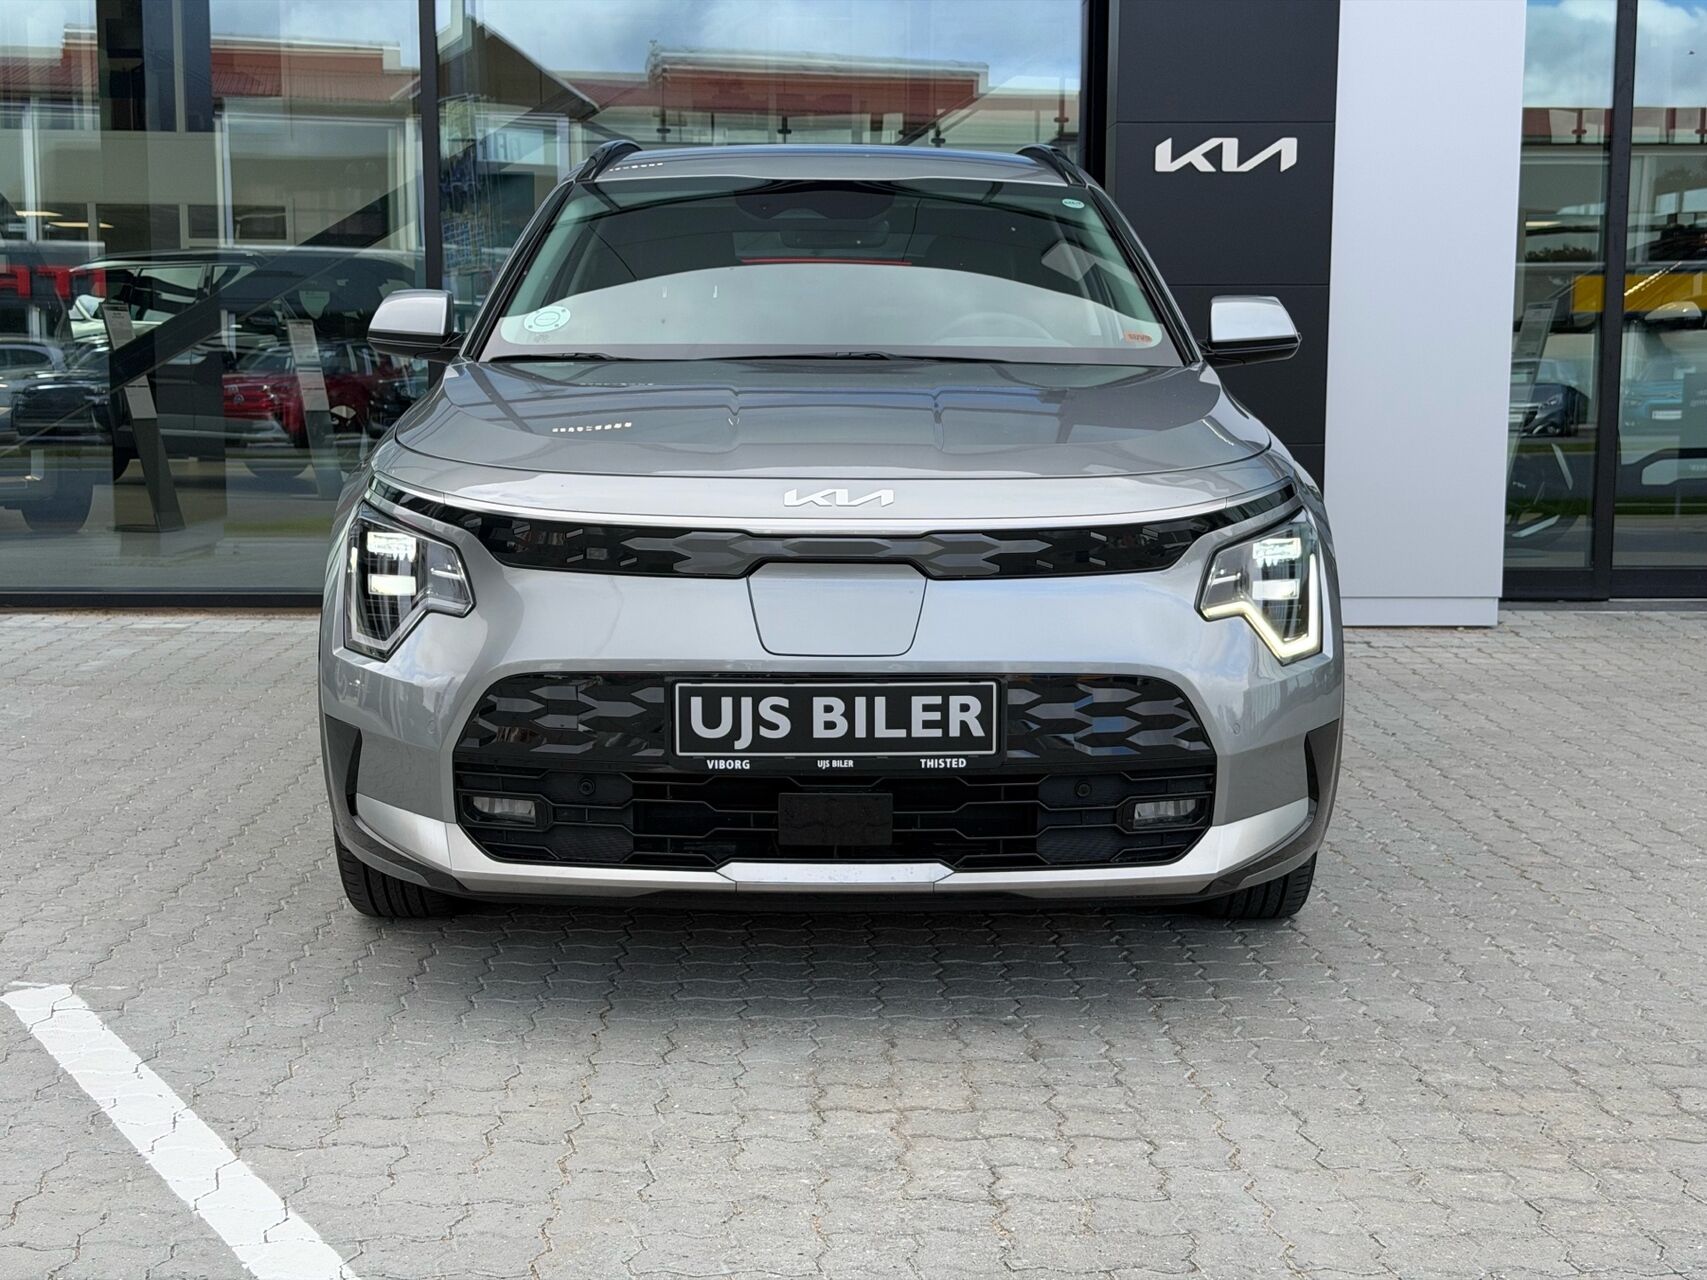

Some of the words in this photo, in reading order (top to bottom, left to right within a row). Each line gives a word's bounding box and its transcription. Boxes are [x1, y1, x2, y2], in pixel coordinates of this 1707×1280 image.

[1155, 137, 1298, 172] KIA
[783, 488, 895, 508] KIA
[690, 696, 792, 750] UJS
[812, 695, 986, 739] BILER
[707, 759, 751, 770] VIBORG
[817, 759, 830, 770] UJS
[831, 759, 854, 768] BILER
[920, 757, 967, 769] THISTED
